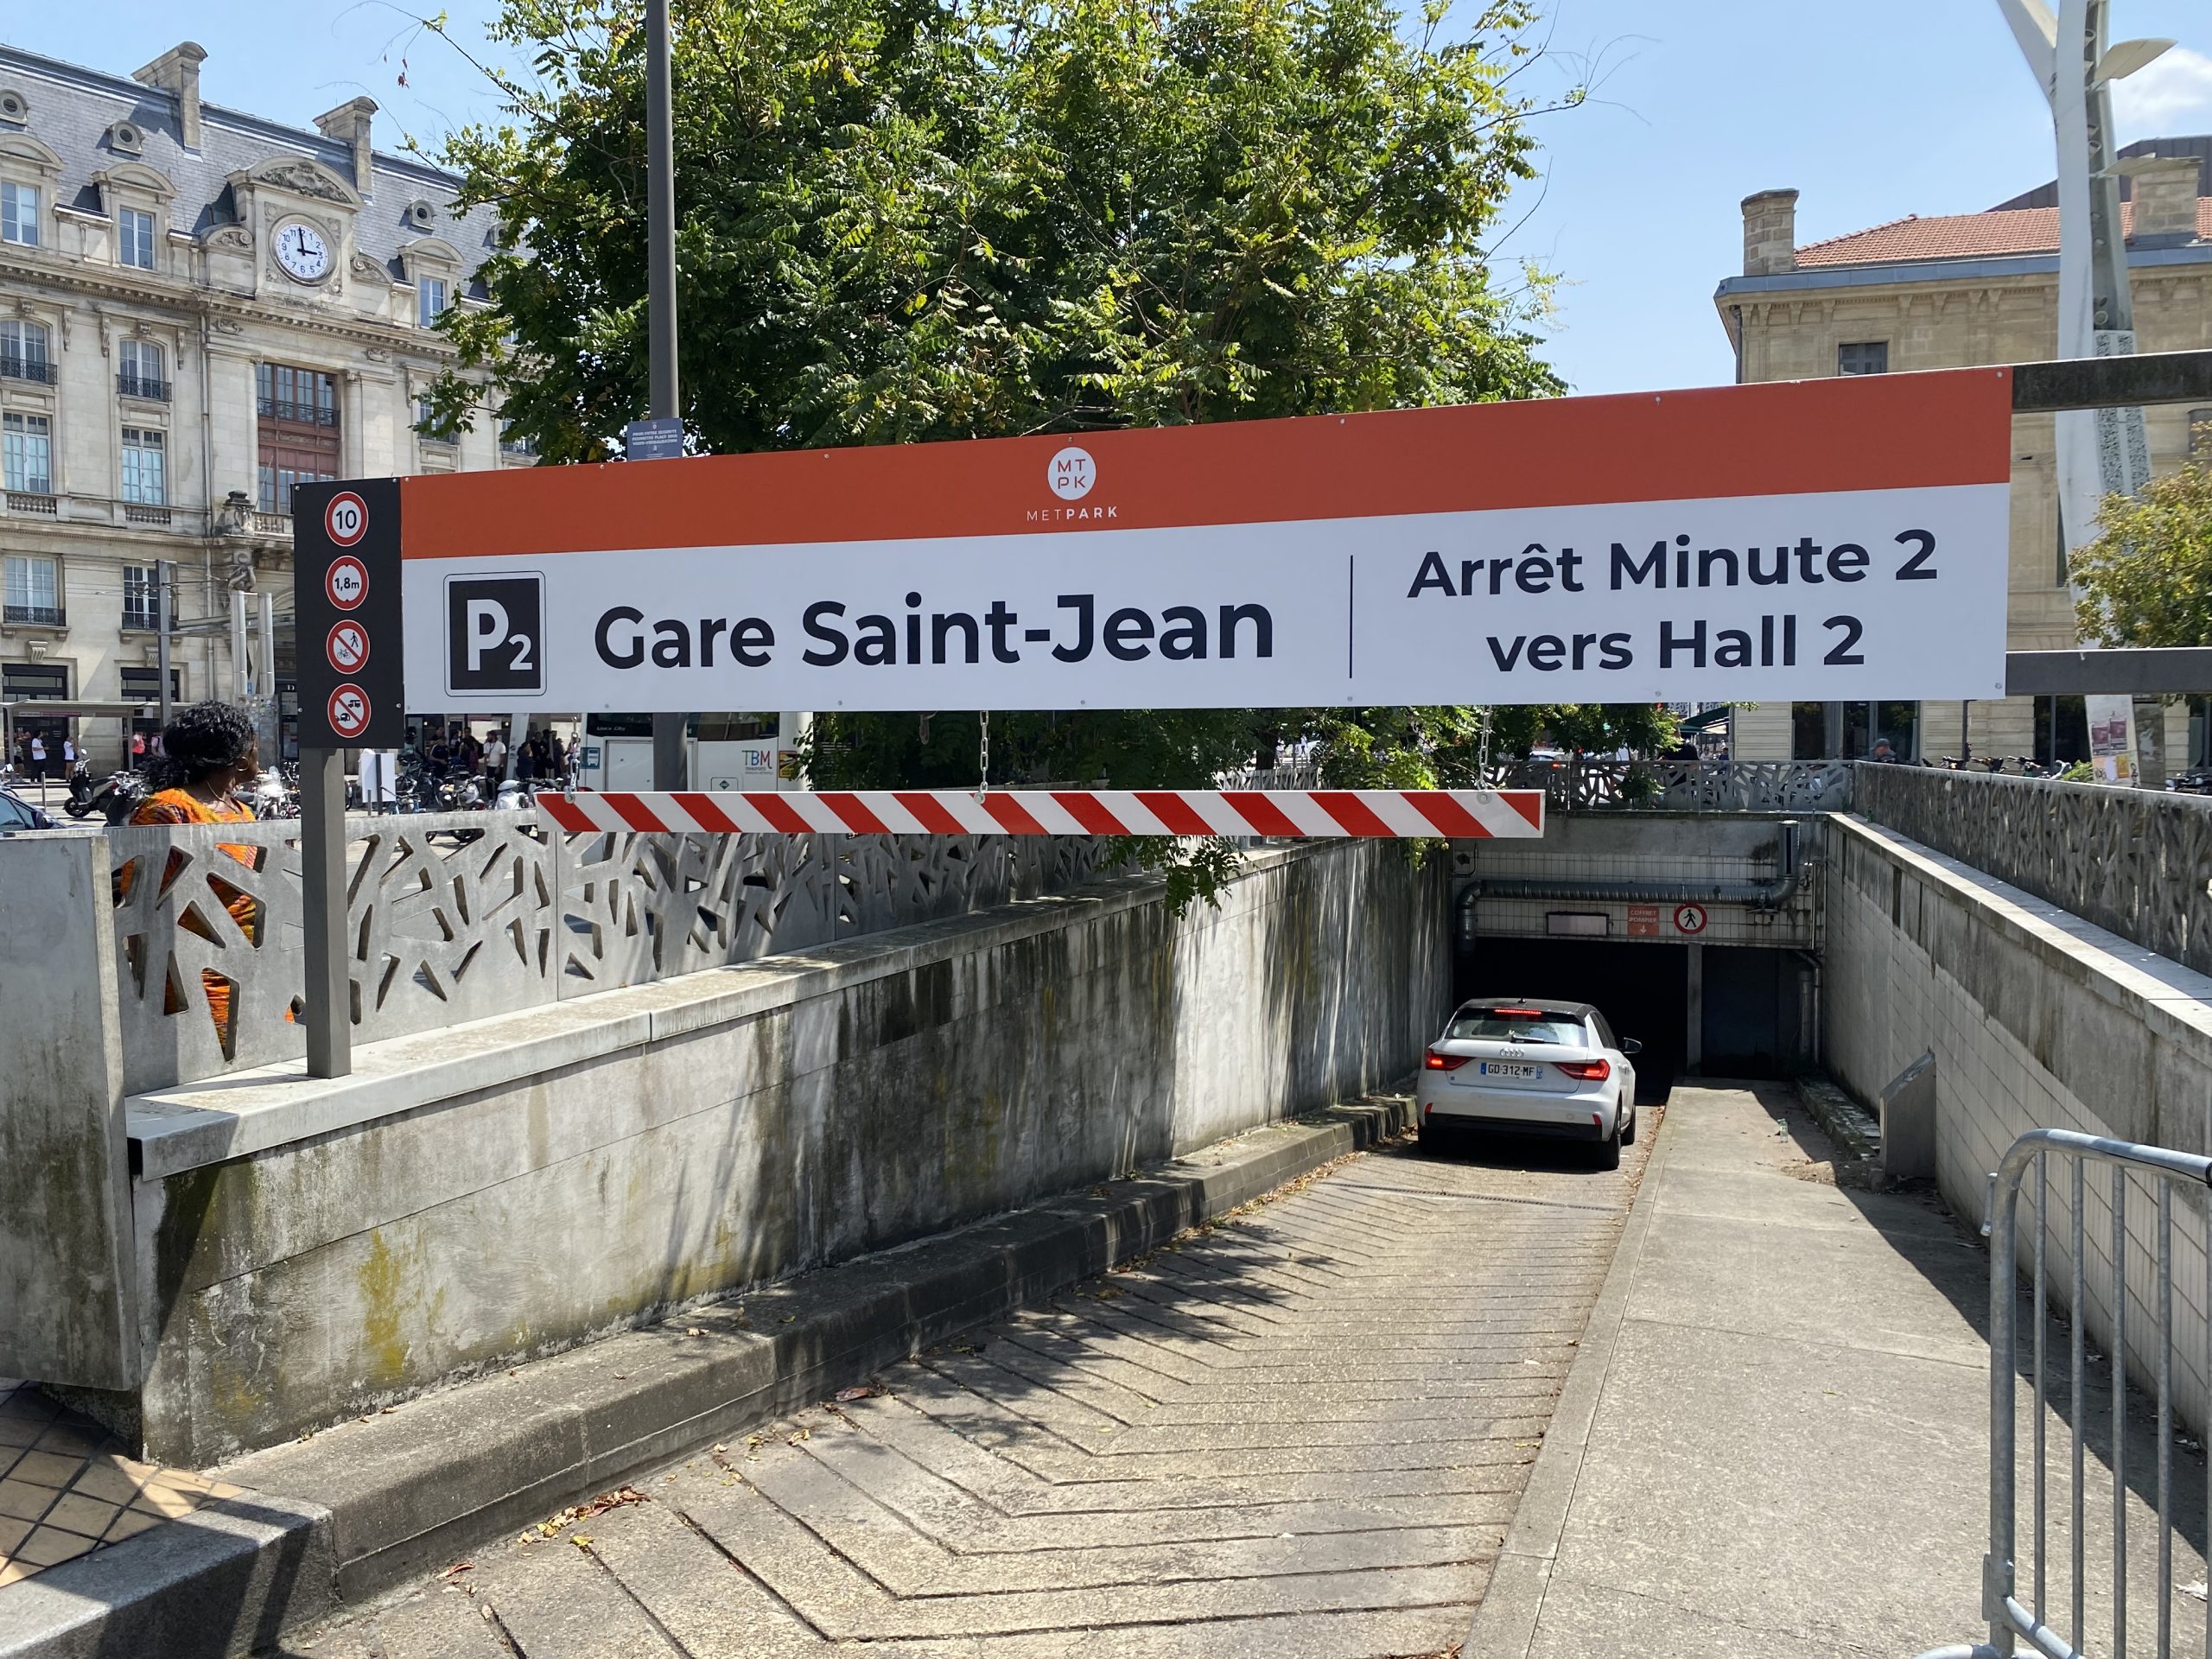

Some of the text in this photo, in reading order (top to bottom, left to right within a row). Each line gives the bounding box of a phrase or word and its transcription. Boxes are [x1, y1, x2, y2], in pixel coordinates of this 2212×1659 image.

[1058, 459, 1086, 473] MT
[1058, 475, 1086, 489] PK
[336, 510, 357, 529] 10
[1027, 506, 1117, 521] METPARK
[1407, 529, 1938, 599] Arrêt Minute 2
[334, 577, 359, 591] 1,8m
[594, 591, 1273, 670] Gare Saint-Jean
[1485, 614, 1865, 672] vers Hall 2
[741, 750, 772, 769] TBM
[1488, 1064, 1535, 1077] GD-312-MF
